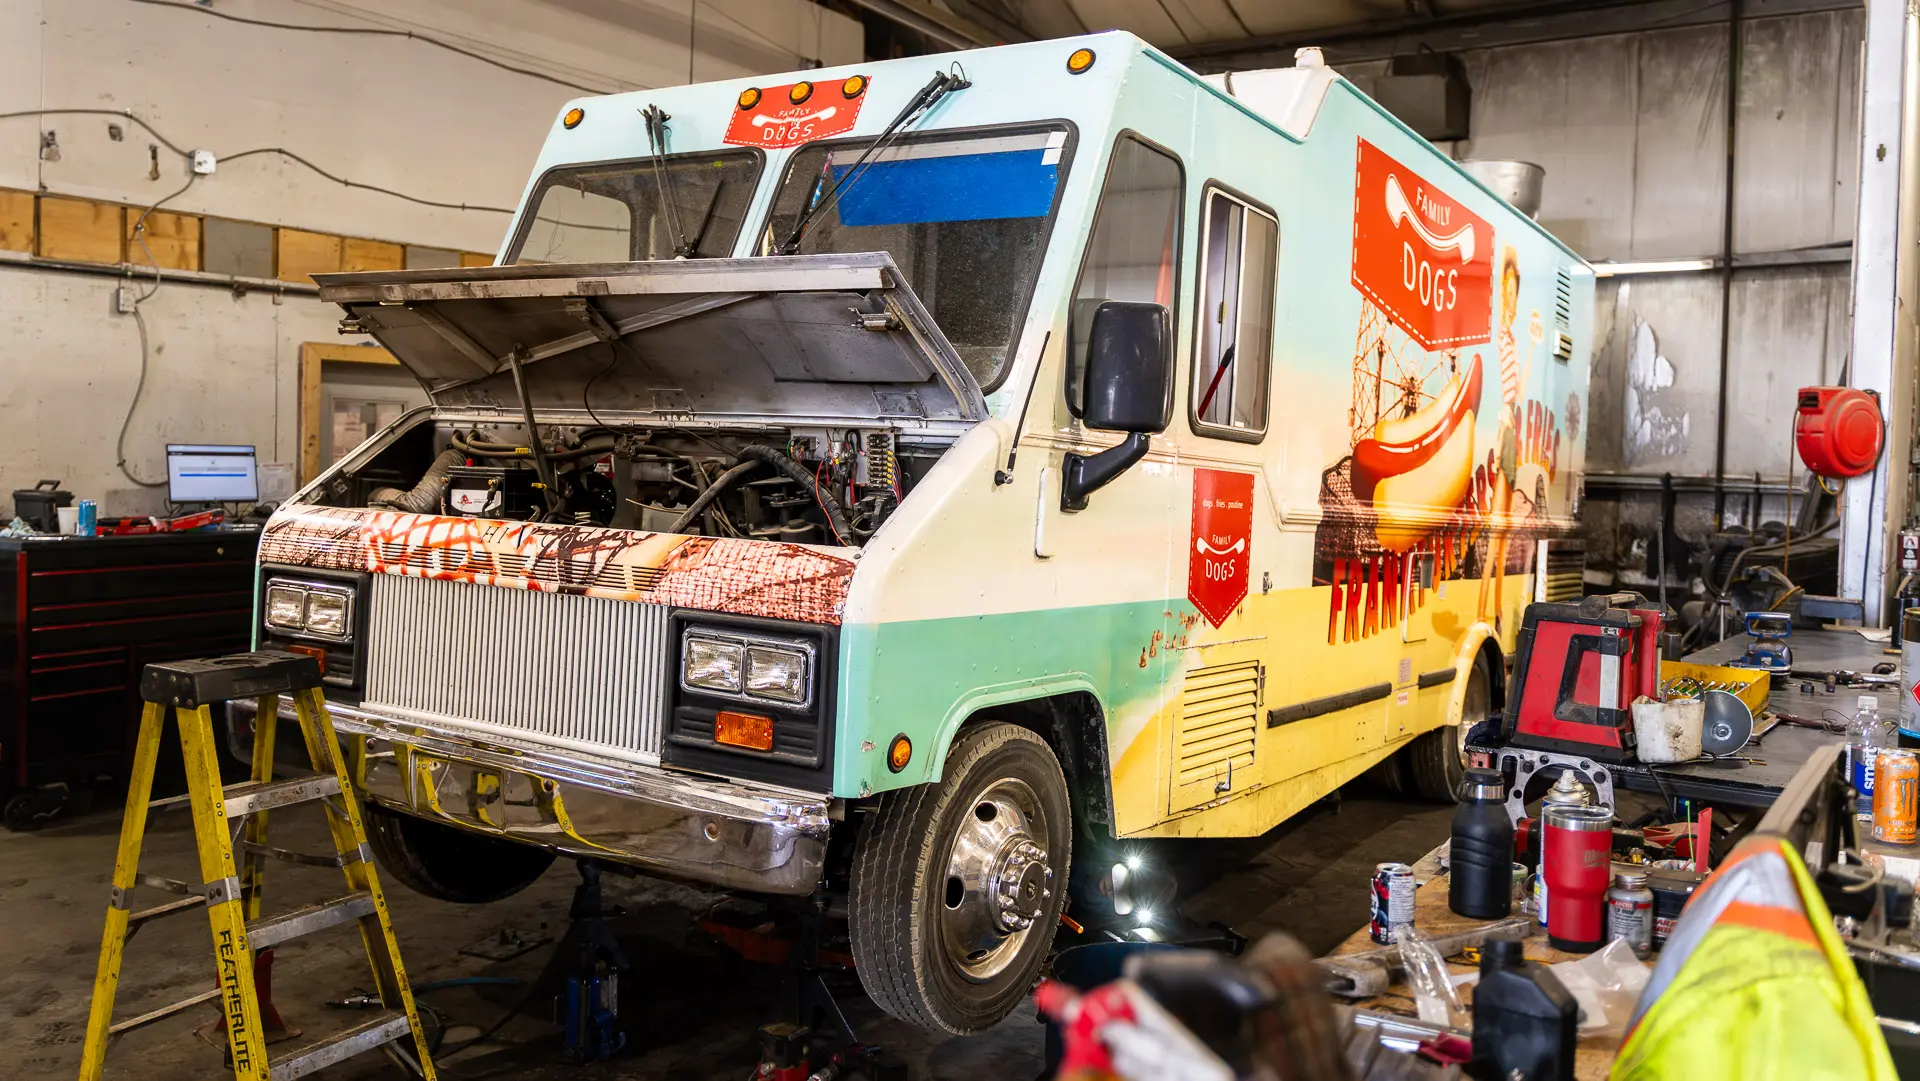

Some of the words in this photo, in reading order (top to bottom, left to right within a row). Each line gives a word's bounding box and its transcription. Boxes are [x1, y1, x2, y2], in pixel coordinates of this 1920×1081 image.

[778, 107, 811, 117] FAMILY
[763, 124, 815, 141] DOGS
[1415, 186, 1451, 227] FAMILY
[1403, 240, 1458, 312] DOGS
[1211, 534, 1232, 546] FAMILY
[1205, 558, 1236, 582] DOGS
[218, 929, 251, 1073] FEATHERLITE
